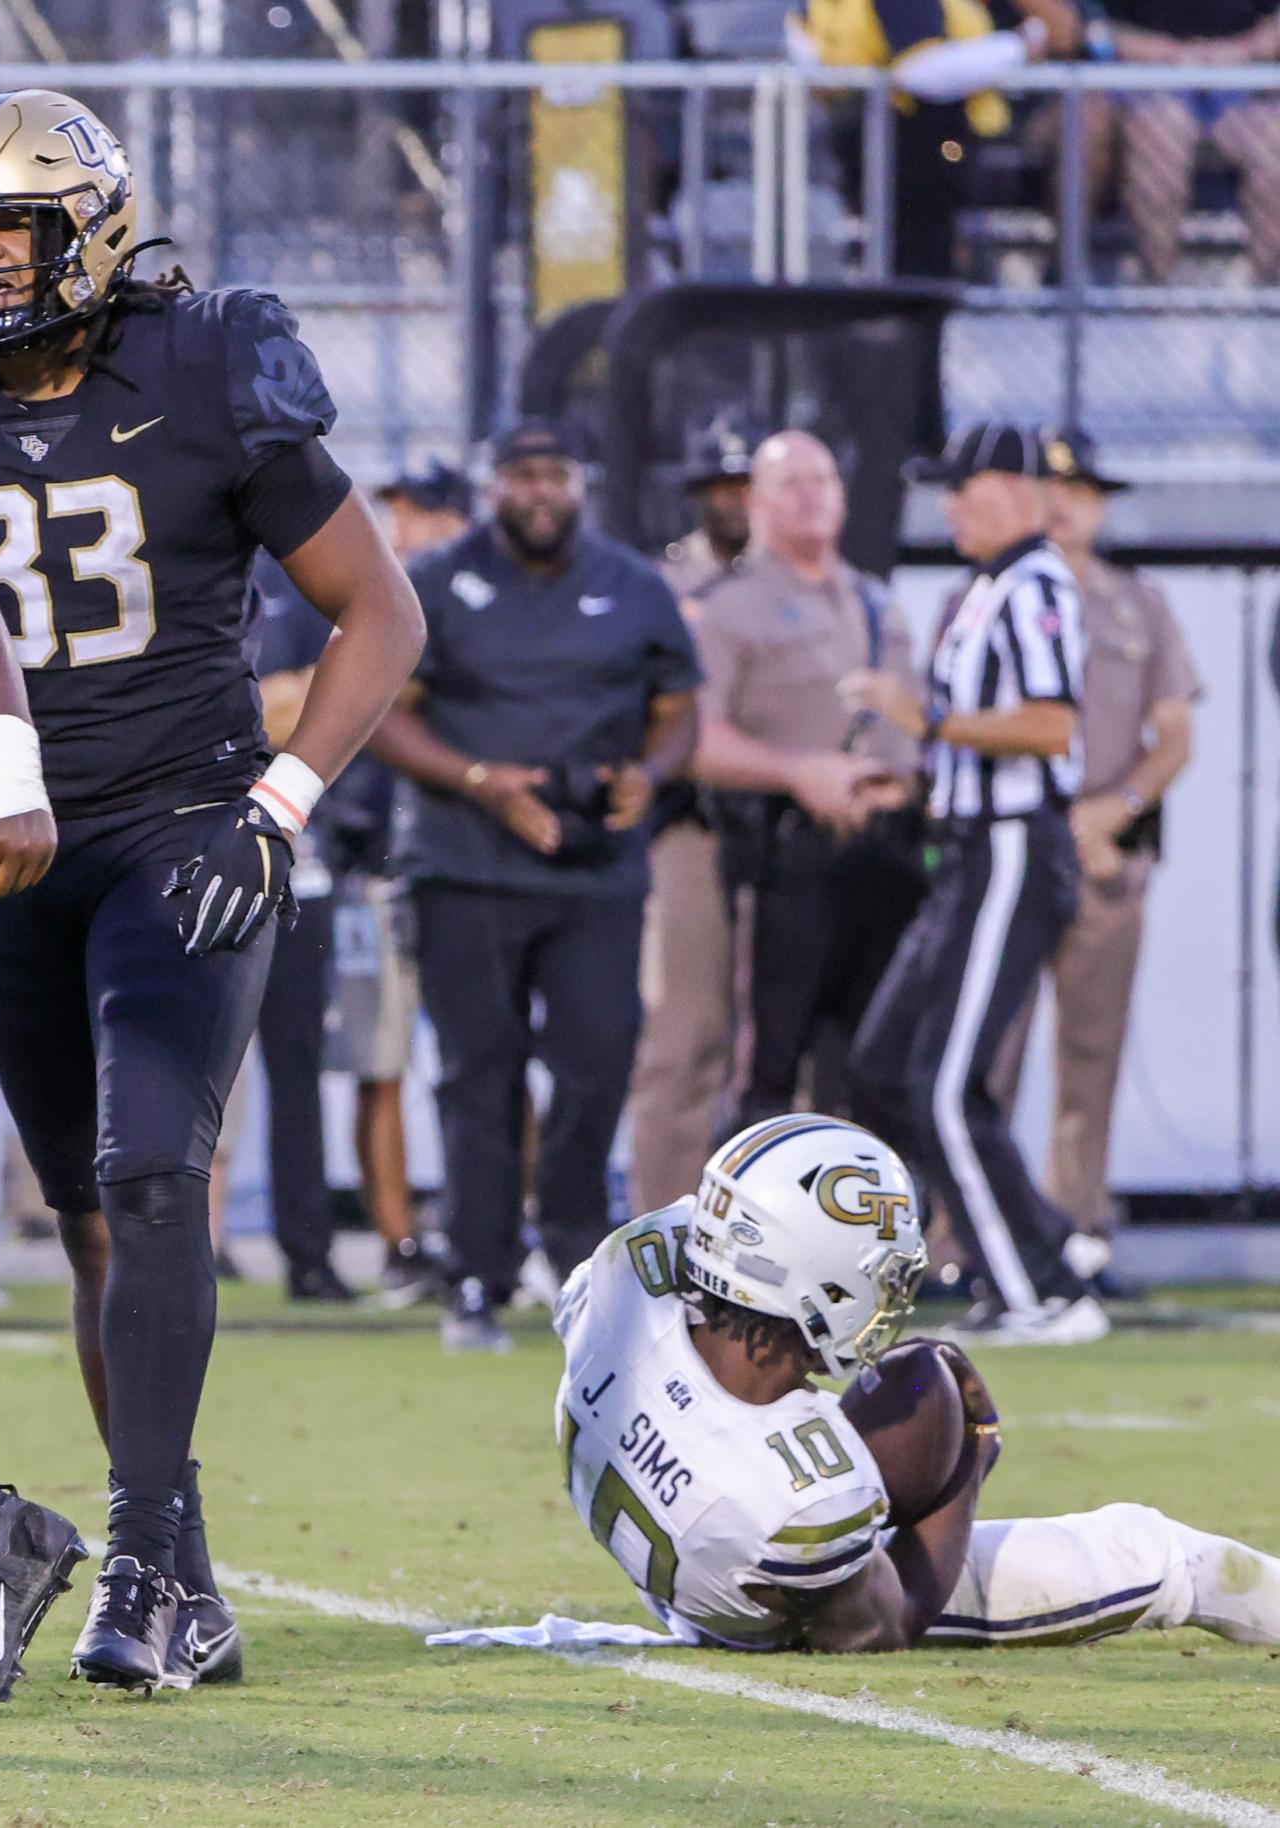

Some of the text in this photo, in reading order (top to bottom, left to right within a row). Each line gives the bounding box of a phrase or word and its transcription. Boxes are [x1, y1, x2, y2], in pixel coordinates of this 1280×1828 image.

[817, 1164, 910, 1241] GT
[582, 1371, 693, 1508] J. SIMS
[764, 1416, 855, 1493] 10
